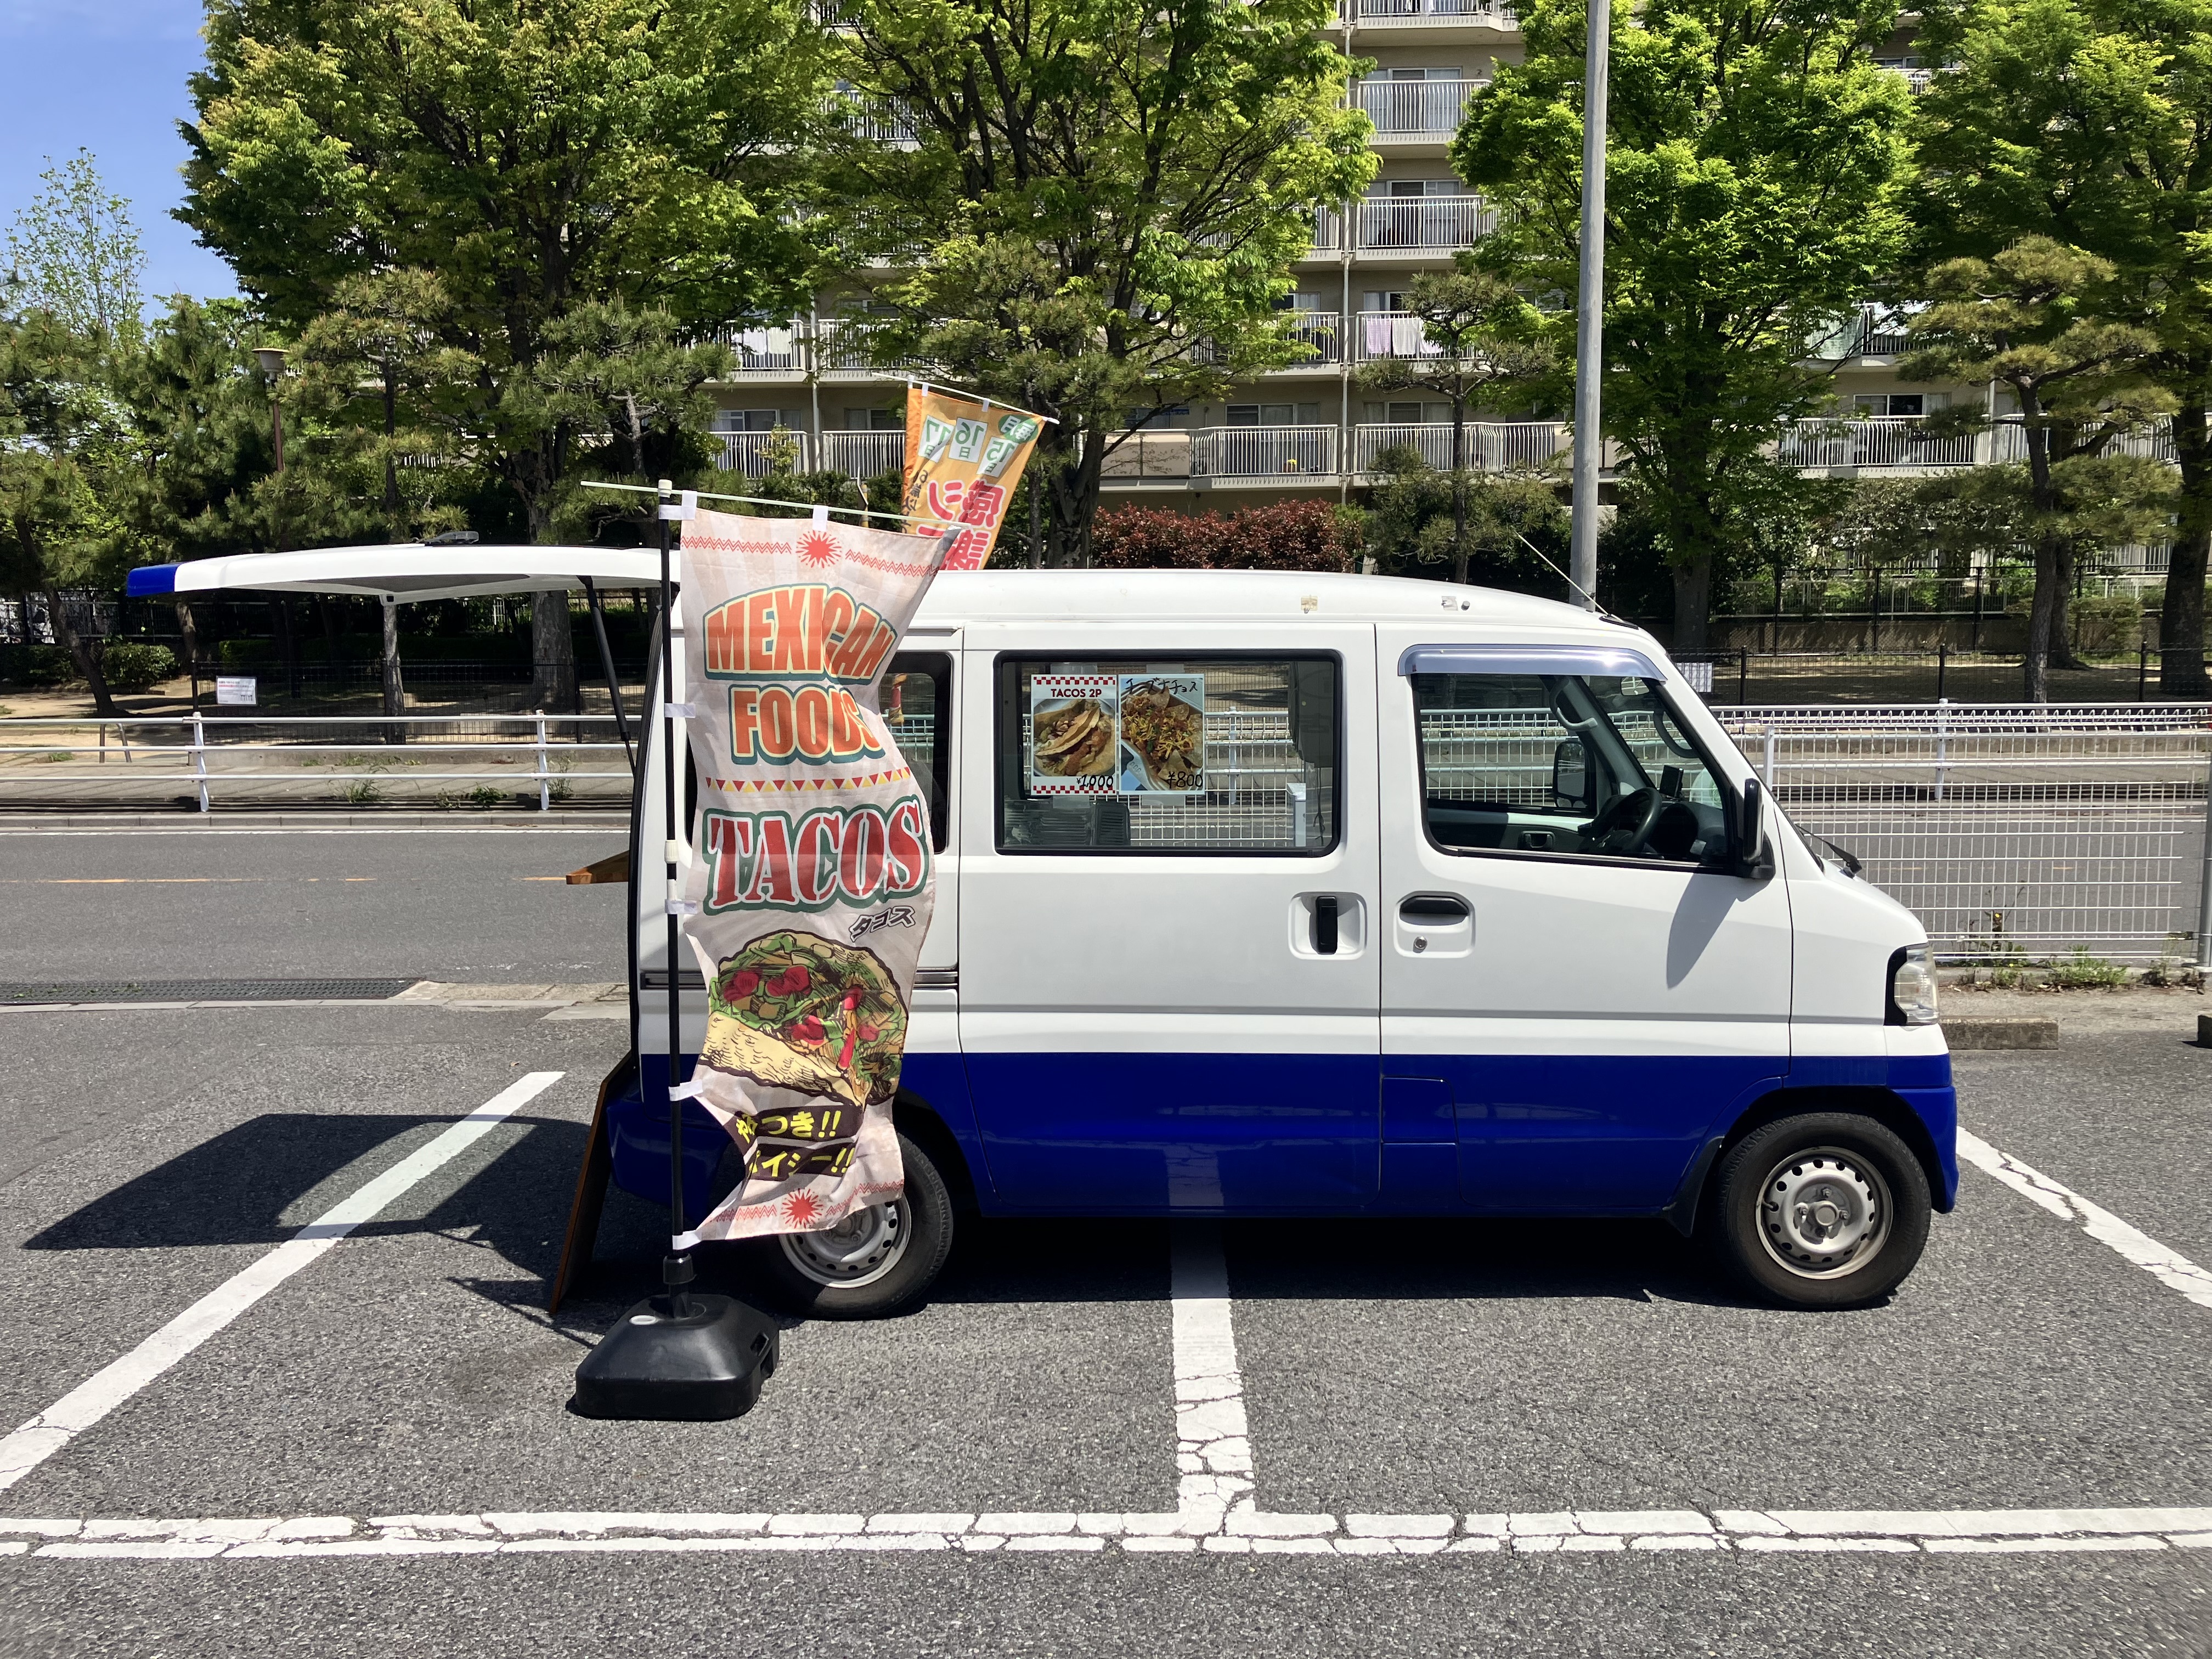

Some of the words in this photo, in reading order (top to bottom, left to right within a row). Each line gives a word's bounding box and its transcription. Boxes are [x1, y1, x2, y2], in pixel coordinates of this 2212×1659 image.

[704, 584, 897, 684] MEXICAN
[1051, 689, 1086, 697] TACOS
[1089, 689, 1102, 697] 2P
[730, 685, 885, 765] FOODS
[1076, 774, 1114, 788] ¥1,000
[1167, 770, 1204, 789] ¥800
[703, 795, 929, 915] TACOS
[850, 906, 916, 941] タコス
